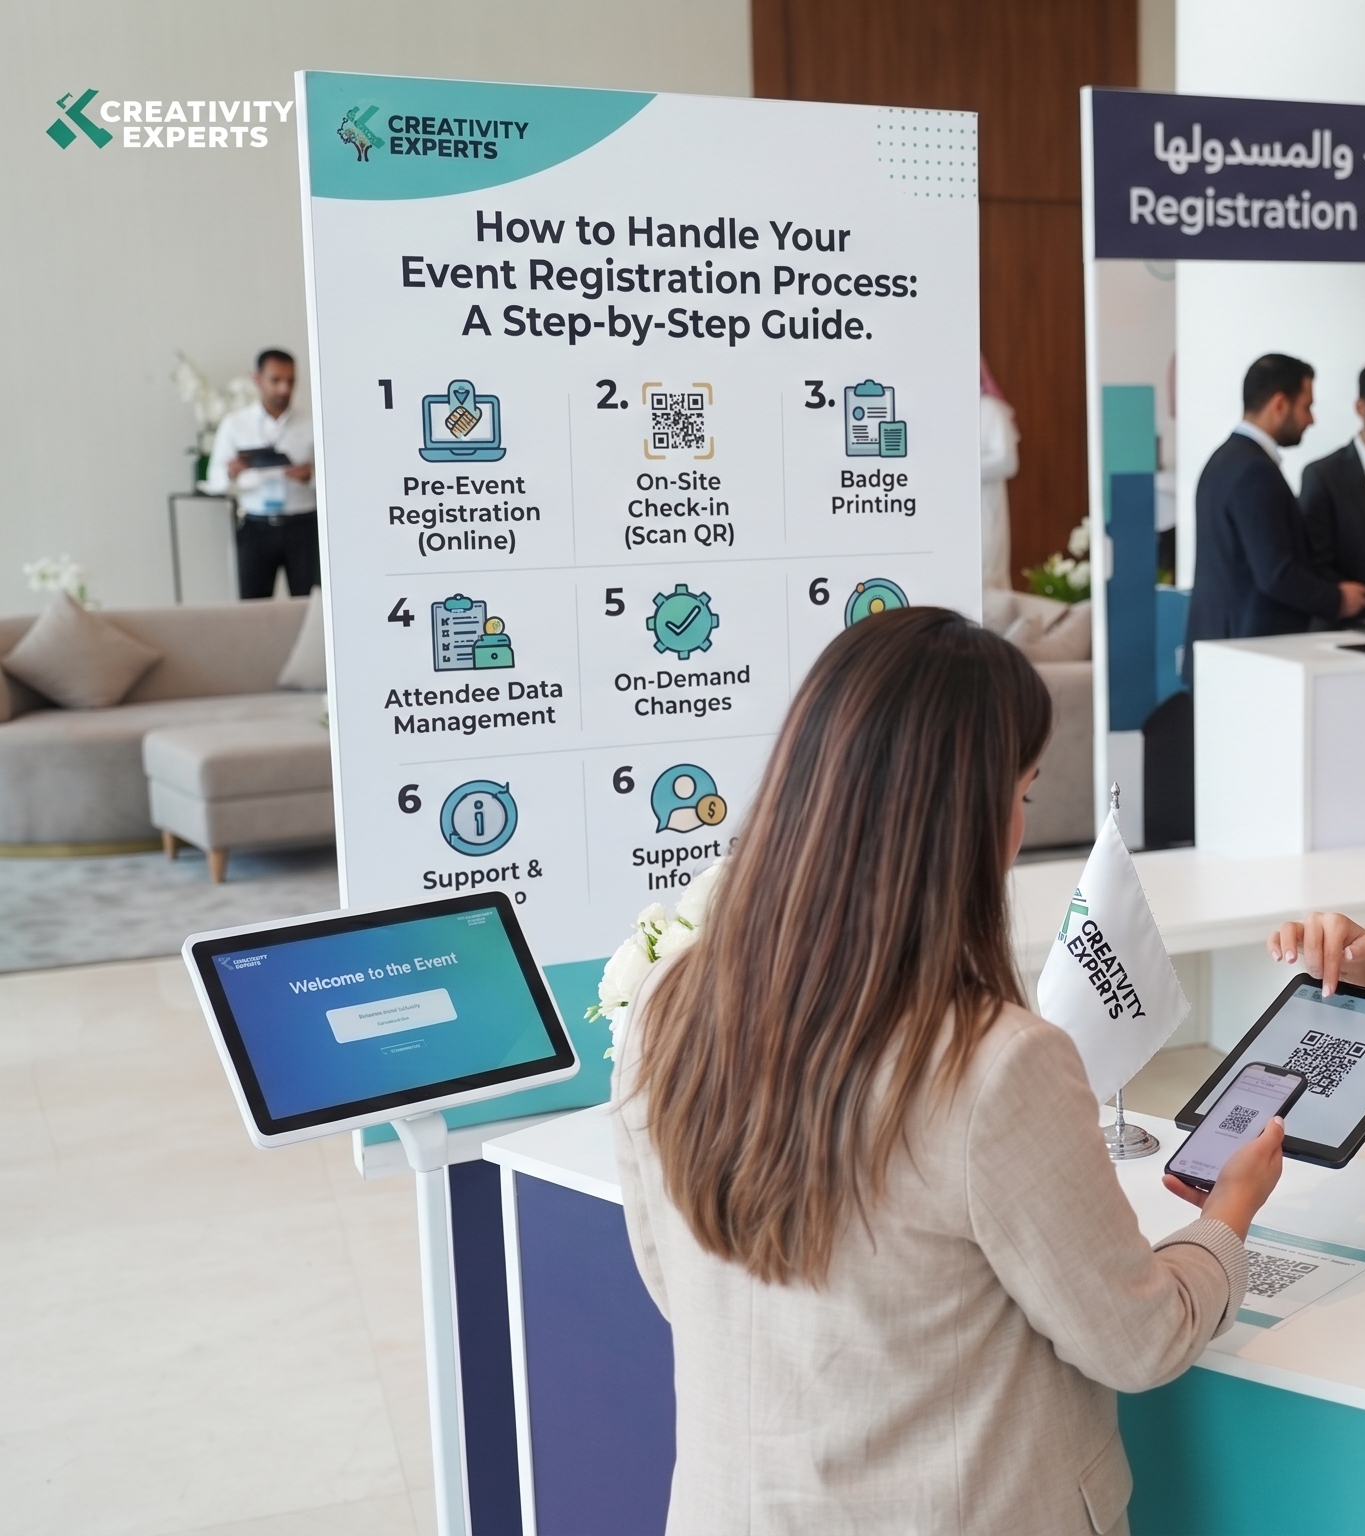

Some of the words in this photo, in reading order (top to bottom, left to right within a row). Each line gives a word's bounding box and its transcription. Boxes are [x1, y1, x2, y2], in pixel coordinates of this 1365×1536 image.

[388, 114, 529, 141] CREATIVITY
[390, 137, 499, 160] EXPERTS
[1129, 186, 1358, 236] Registration
[476, 210, 566, 244] How
[575, 215, 616, 246] to
[628, 215, 760, 250] Handle
[768, 220, 851, 252] Your
[401, 255, 518, 290] Event
[529, 257, 761, 300] Registration
[773, 265, 918, 298] Process:
[461, 304, 492, 336] A
[503, 304, 751, 348] Step-by-Step
[761, 306, 873, 340] Guide.
[378, 379, 394, 410] 1
[595, 378, 629, 410] 2.
[804, 380, 836, 410] 3.
[403, 475, 526, 496] Pre-Event
[636, 470, 721, 491] On-Site
[841, 468, 908, 493] Badge
[388, 502, 541, 527] Registration
[628, 496, 729, 519] Check-in
[831, 493, 916, 517] Printing
[418, 530, 516, 557] (Online)
[624, 525, 687, 550] (Scan
[694, 522, 735, 547] QR)
[604, 587, 626, 617] 5
[808, 577, 830, 606] 6
[387, 597, 415, 628] 4
[614, 664, 750, 692] On-Demand
[384, 683, 501, 709] Attendee
[508, 680, 563, 701] Data
[634, 696, 732, 718] Changes
[394, 705, 556, 736] Management
[612, 765, 635, 795] 6
[397, 783, 422, 814] 6
[632, 840, 722, 869] Support
[423, 862, 521, 890] Support
[527, 859, 543, 879] &
[648, 868, 692, 891] Info
[289, 972, 365, 994] Welcome
[368, 967, 385, 980] to
[385, 962, 411, 977] the
[414, 952, 458, 971] Event
[1067, 936, 1123, 1020] EXPERTS
